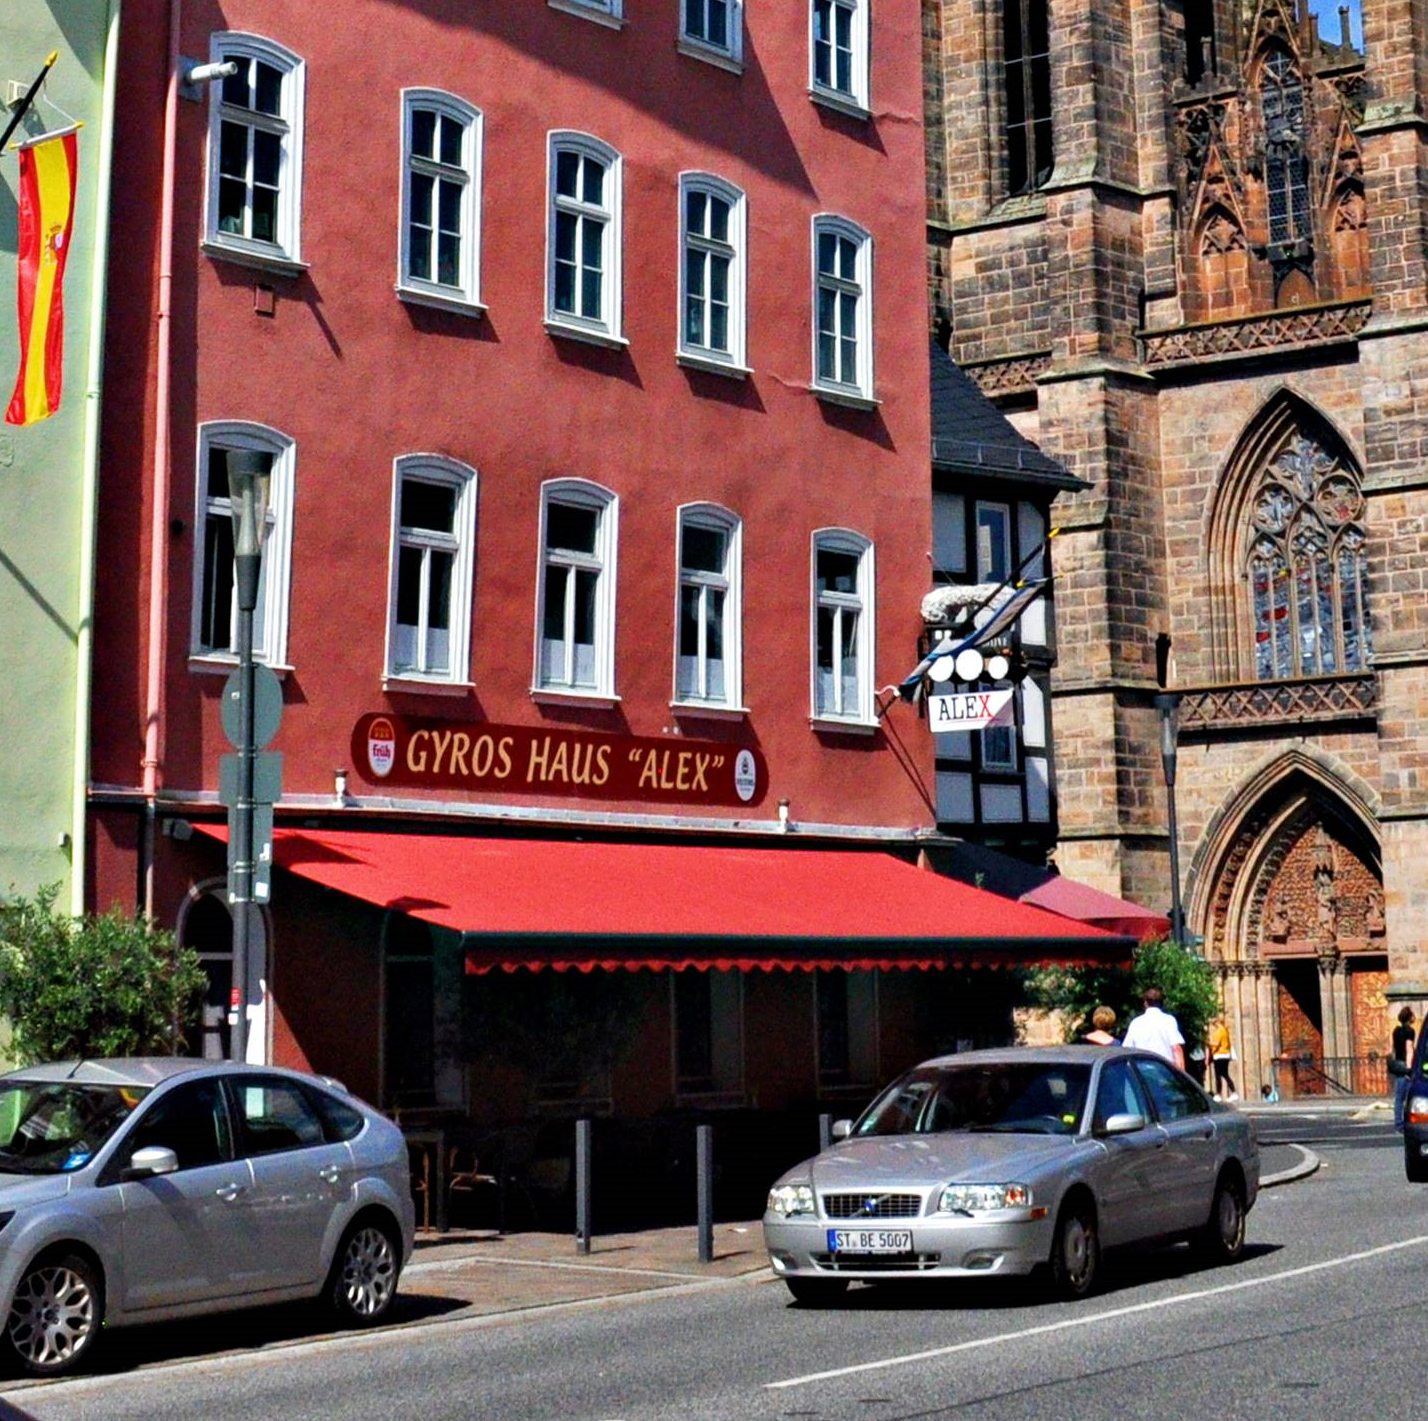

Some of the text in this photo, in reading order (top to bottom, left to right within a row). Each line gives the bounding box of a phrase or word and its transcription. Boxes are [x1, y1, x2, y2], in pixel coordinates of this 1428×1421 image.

[939, 694, 994, 721] ALEX
[407, 729, 514, 778] GYROS
[527, 736, 611, 786] HAUS
[837, 1233, 909, 1248] ST BE 5007
